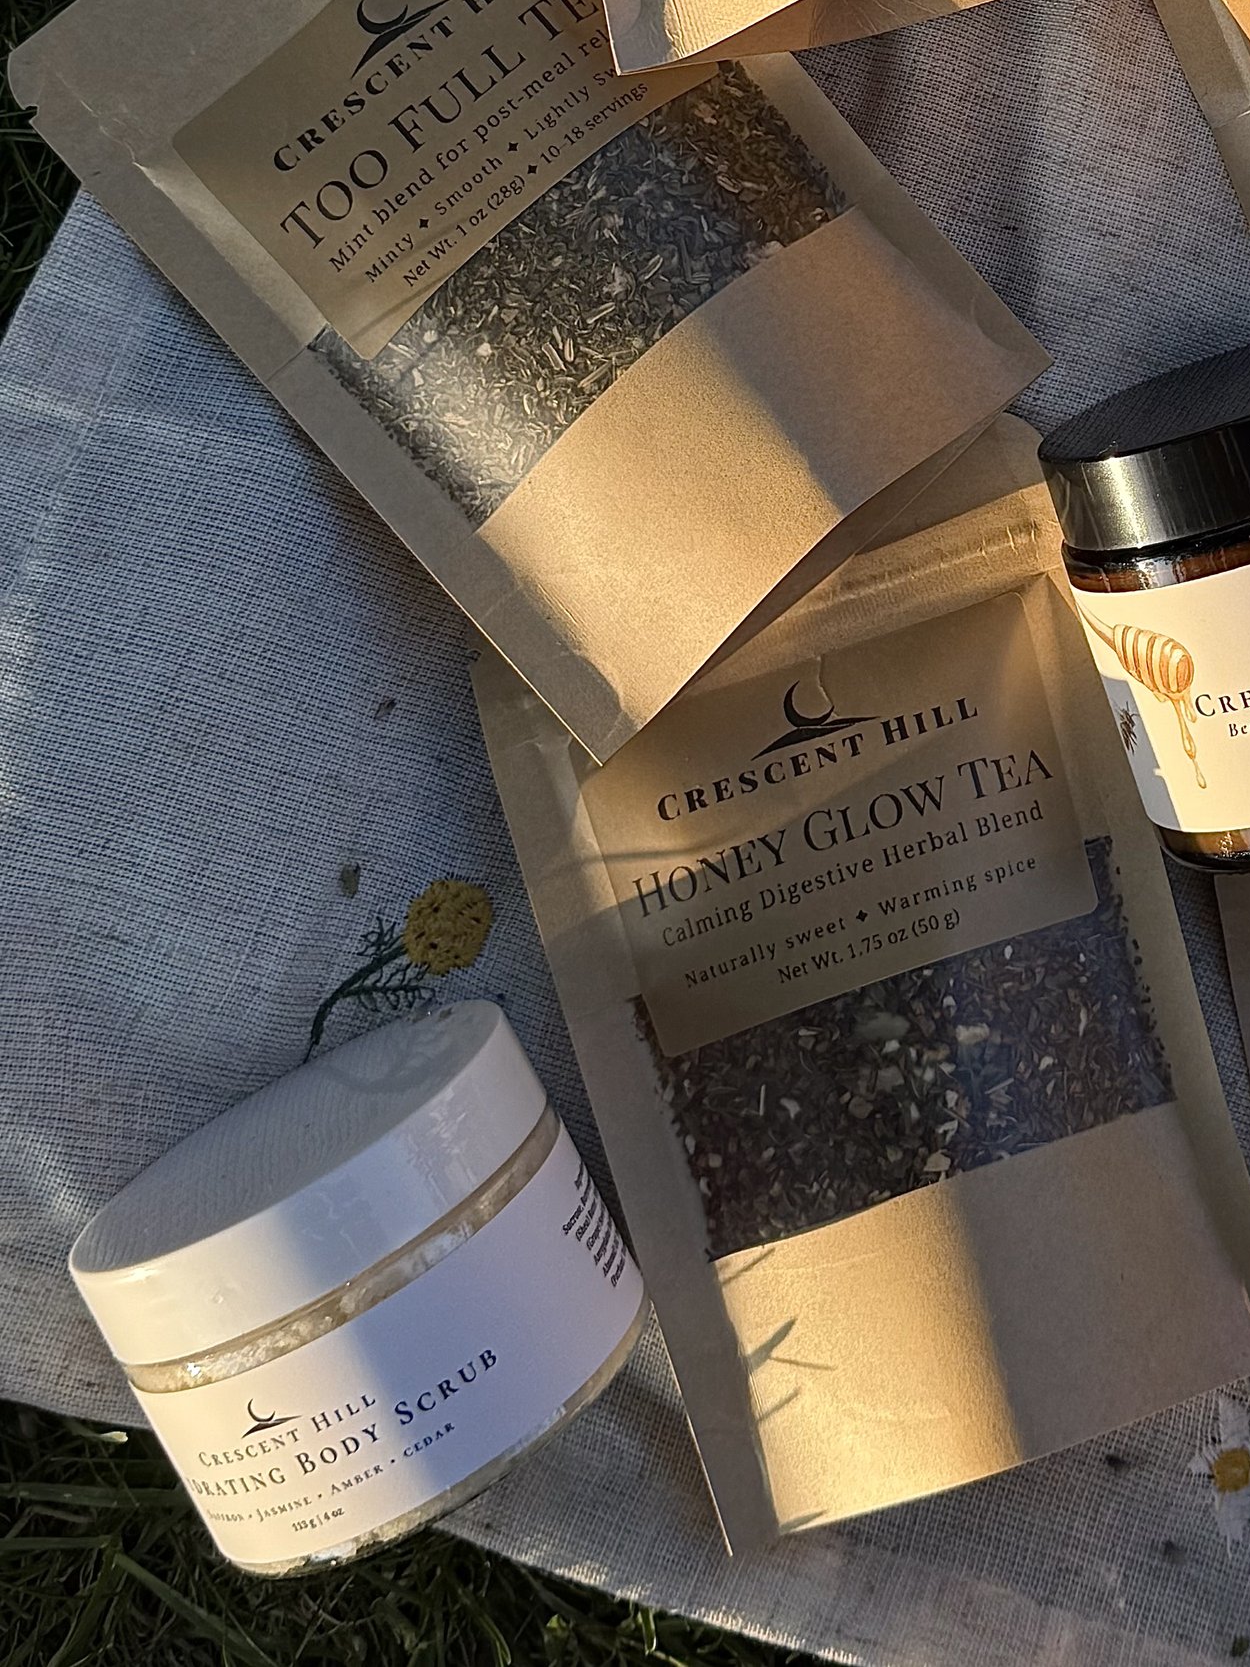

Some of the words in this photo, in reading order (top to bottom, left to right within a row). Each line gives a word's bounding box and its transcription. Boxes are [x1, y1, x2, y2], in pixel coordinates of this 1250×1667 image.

[272, 17, 454, 172] CRESCENT
[280, 151, 389, 249] TOO
[389, 46, 526, 153] FULL
[329, 222, 374, 272] Mint
[377, 167, 435, 223] blend
[437, 139, 467, 175] for
[474, 52, 575, 144] post-meal
[365, 232, 415, 283] Minty
[434, 156, 503, 217] Smooth
[524, 84, 590, 139] Lightly
[403, 262, 429, 287] Net
[458, 223, 468, 236] 1
[469, 209, 488, 228] oz
[488, 175, 525, 214] (28g)
[584, 82, 648, 130] servings
[658, 734, 864, 821] CRESCENT
[881, 698, 978, 744] HILL
[632, 831, 787, 917] HONEY
[803, 776, 946, 851] GLOW
[957, 749, 1053, 799] TEA
[663, 900, 753, 947] Calming
[762, 857, 874, 911] Digestive
[883, 823, 968, 867] Herbal
[979, 801, 1044, 837] Blend
[685, 944, 776, 988] Naturally
[786, 917, 846, 949] sweet
[878, 873, 978, 916] Warming
[985, 856, 1036, 886] spice
[778, 965, 808, 984] Net
[849, 934, 883, 961] 1.75
[888, 929, 909, 944] oz
[912, 914, 939, 941] (50
[944, 909, 960, 932] g)
[198, 1429, 301, 1467] CRESCENT
[309, 1393, 376, 1433] HILL
[295, 1423, 380, 1475] BODY
[394, 1348, 498, 1425] SCRUB
[330, 1464, 383, 1495] AMBER
[403, 1423, 455, 1457] CEDAR
